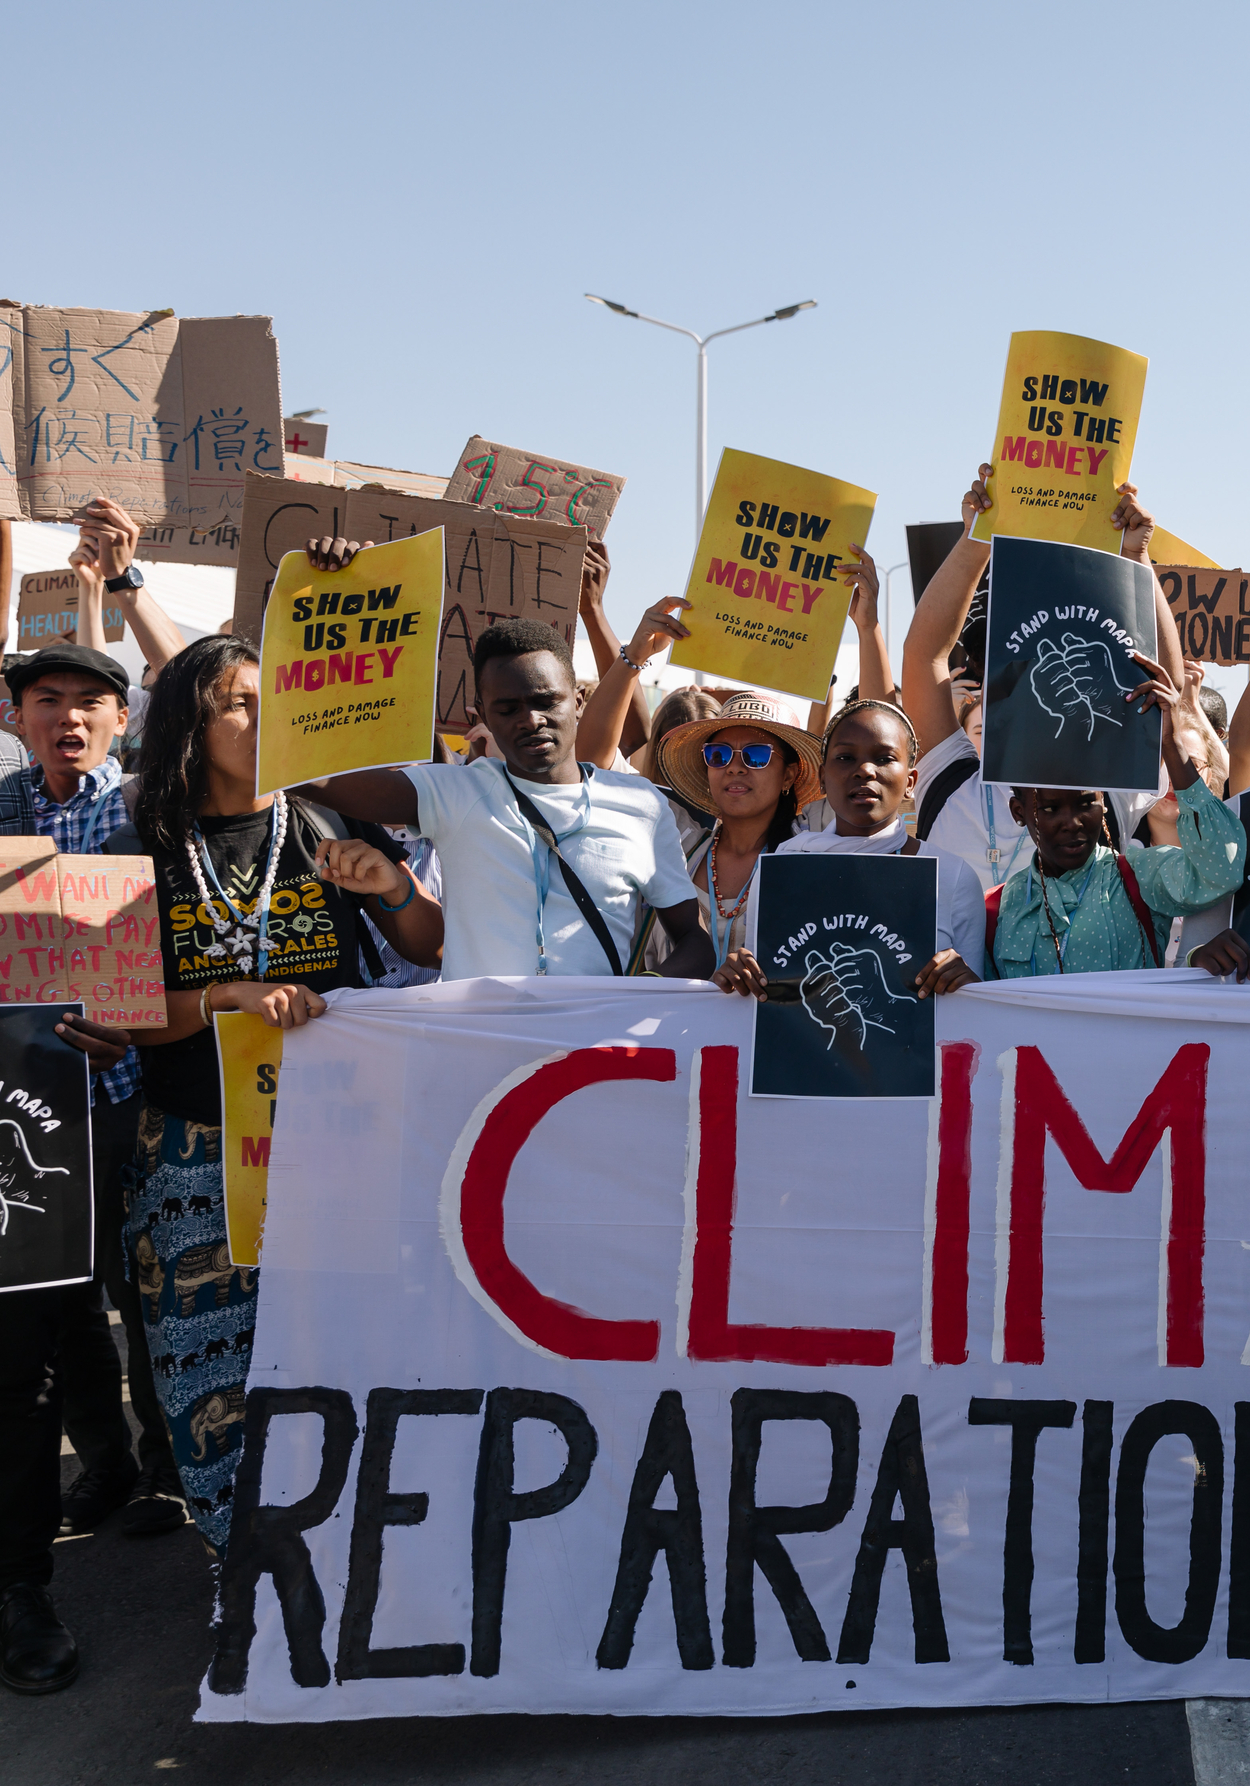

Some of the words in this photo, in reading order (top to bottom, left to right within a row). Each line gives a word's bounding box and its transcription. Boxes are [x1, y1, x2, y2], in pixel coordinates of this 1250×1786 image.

[0, 318, 155, 403] すぐ
[1021, 374, 1110, 407] SHOW
[1028, 405, 1064, 437] US
[1073, 410, 1123, 444] THE
[1000, 436, 1110, 476] MONEY
[1011, 486, 1034, 495] LOSS
[1036, 488, 1055, 497] AND
[1058, 490, 1098, 502] DAMAGE
[1019, 497, 1060, 508] FINANCE
[1062, 501, 1085, 512] NOW
[735, 500, 831, 543] SHOW
[264, 503, 568, 609] CATE
[740, 532, 781, 569] US
[788, 544, 843, 582] THE
[292, 584, 402, 622] SHOW
[705, 557, 825, 615] MONEY
[1159, 571, 1228, 614] OW
[303, 622, 348, 652] US
[358, 611, 421, 644] THE
[715, 612, 741, 626] LOSS
[743, 619, 764, 631] AND
[767, 625, 809, 643] DAMAGE
[724, 625, 768, 643] FINANCE
[770, 637, 794, 650] NOW
[1005, 610, 1050, 654] STAND
[1054, 605, 1100, 622] WITH
[1100, 618, 1142, 658] MAPA
[275, 646, 405, 695] MONEY
[292, 712, 318, 726] LOSS
[322, 706, 344, 719] AND
[348, 697, 397, 713] DAMAGE
[303, 715, 350, 735] FINANCE
[354, 711, 381, 724] NOW
[106, 909, 159, 948] PAY
[773, 922, 817, 968] STAND
[822, 914, 869, 931] WITH
[869, 923, 913, 965] MAPA
[18, 945, 108, 977] THAT
[178, 933, 339, 973] ANCRALES
[92, 1007, 167, 1024] INANCE
[6, 1088, 62, 1133] MAPA
